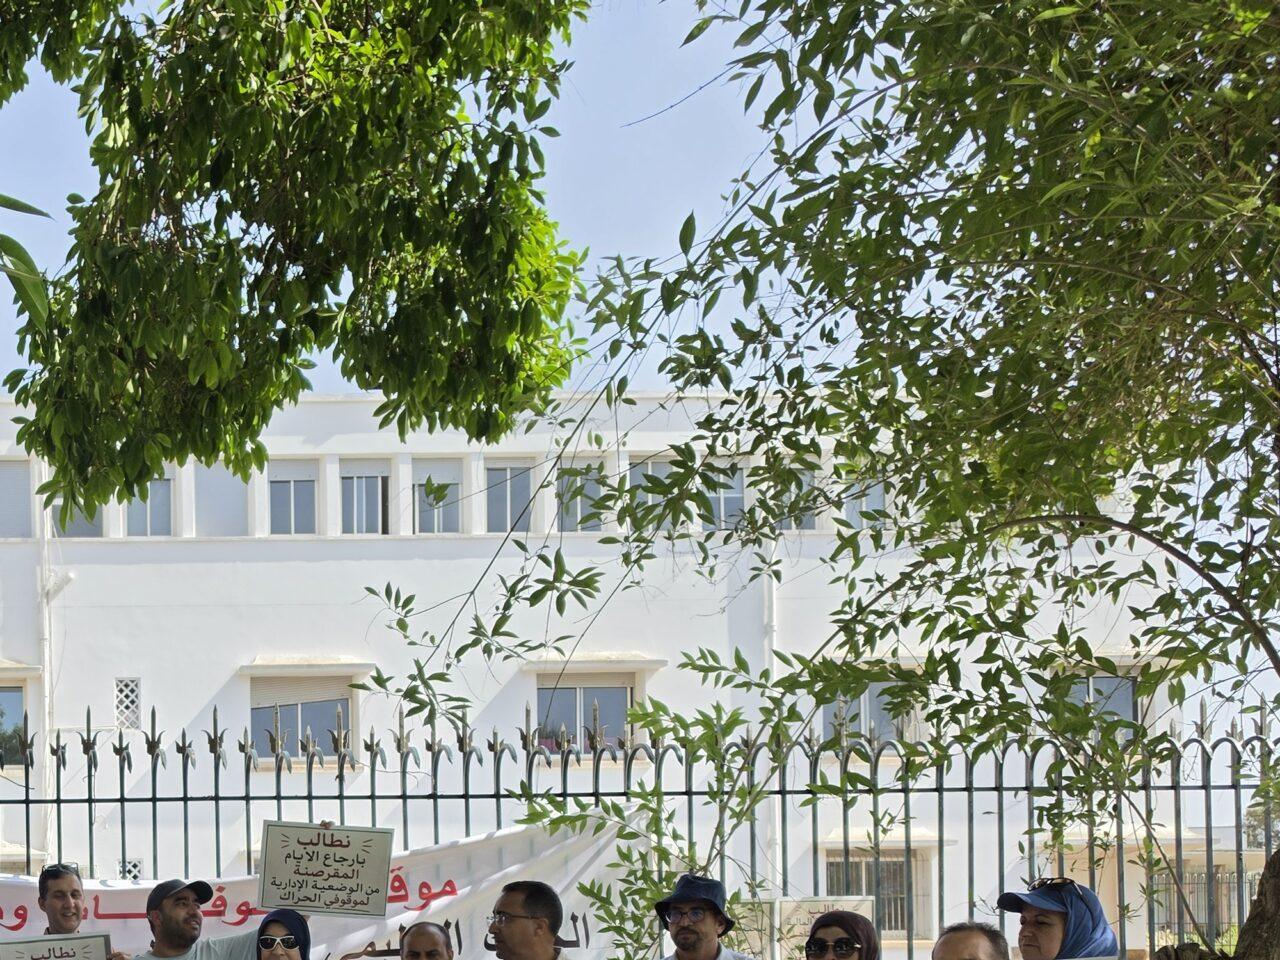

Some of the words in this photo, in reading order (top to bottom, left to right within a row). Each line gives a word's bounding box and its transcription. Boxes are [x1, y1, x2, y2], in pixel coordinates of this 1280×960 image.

[297, 832, 350, 850] نطالب
[285, 850, 319, 864] الايام
[323, 853, 365, 868] بارجاع
[293, 865, 358, 881] المقرصنة
[271, 877, 308, 891] الإدارية
[312, 880, 362, 894] الوضعية
[280, 891, 320, 905] الحراك
[366, 887, 379, 896] من
[324, 893, 369, 909] لموقوفي
